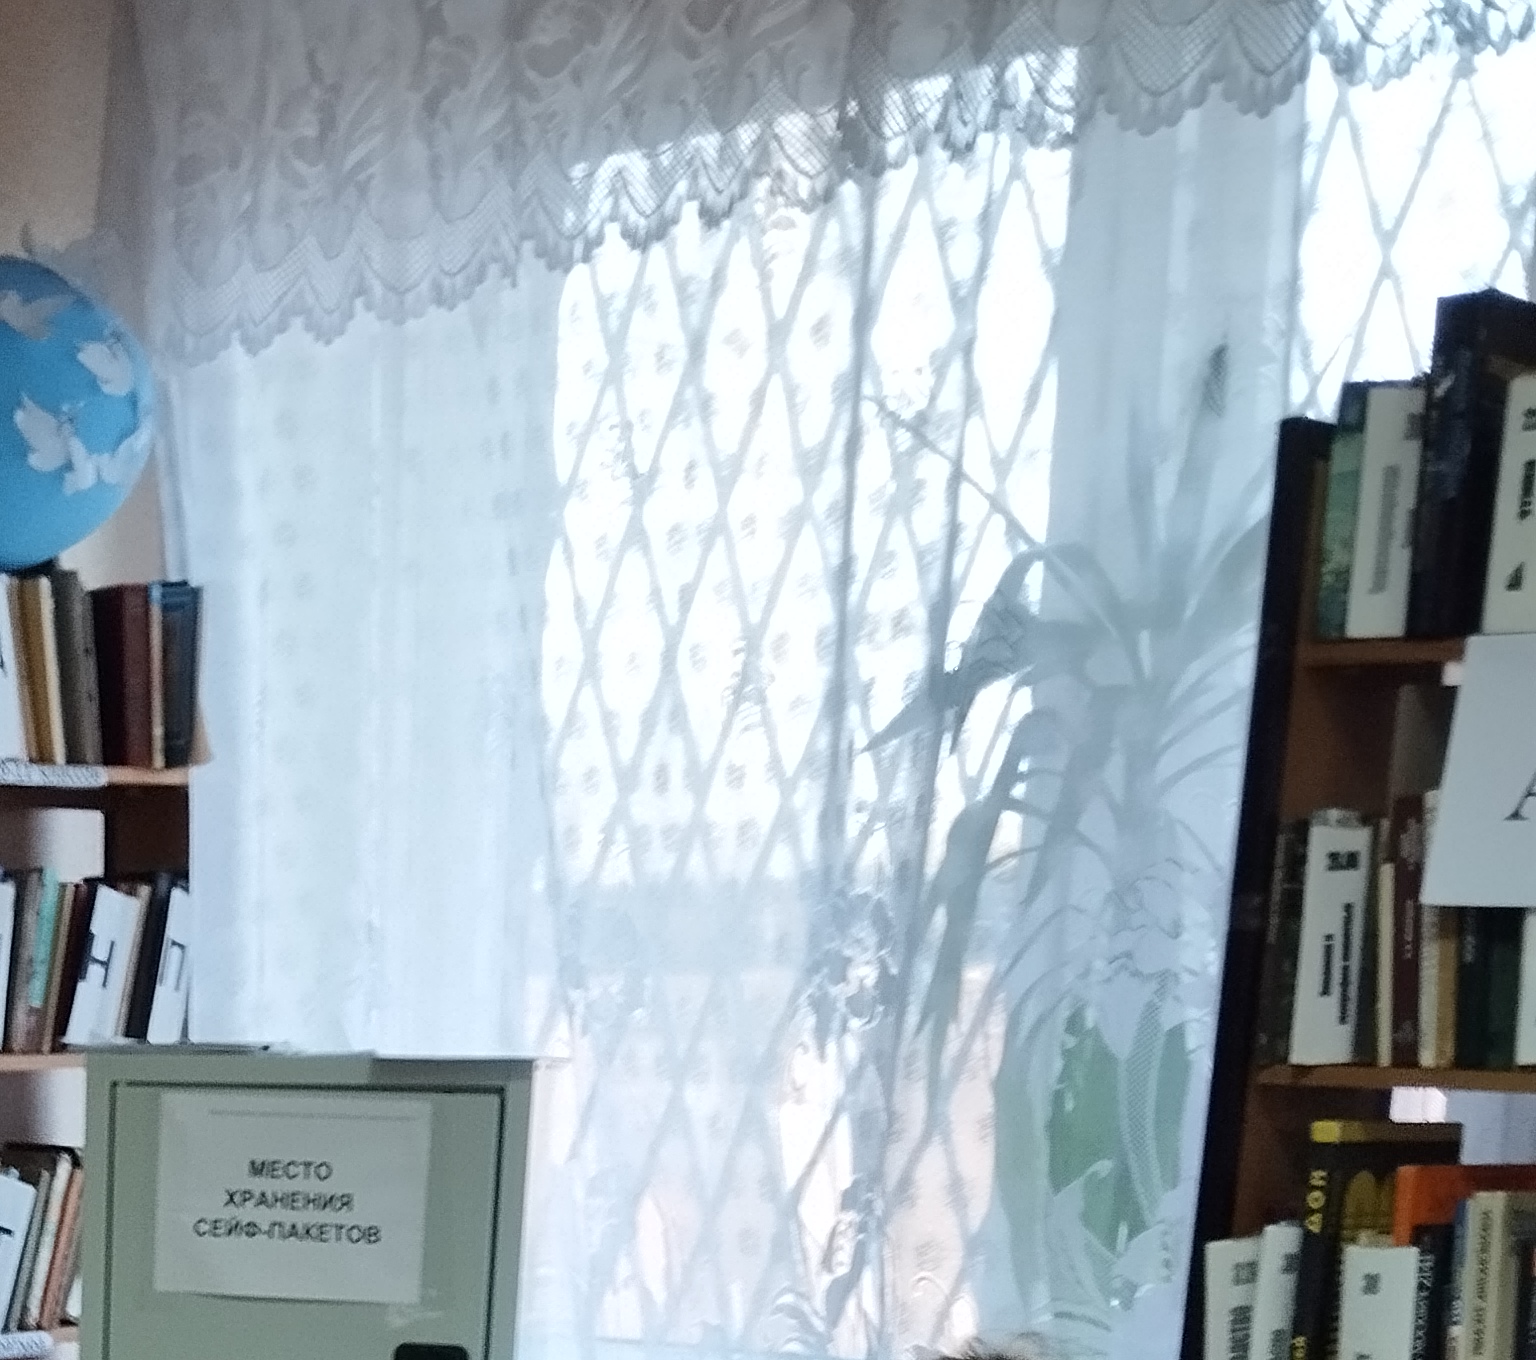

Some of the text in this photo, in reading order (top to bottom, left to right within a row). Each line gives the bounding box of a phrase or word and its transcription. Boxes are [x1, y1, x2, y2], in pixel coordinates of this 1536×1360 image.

[83, 931, 116, 990] Н
[248, 1158, 334, 1182] МЕСТО
[223, 1188, 355, 1213] ХРАНЕНИЯ
[192, 1215, 382, 1245] СЕЙФ-ПАКЕТОВ
